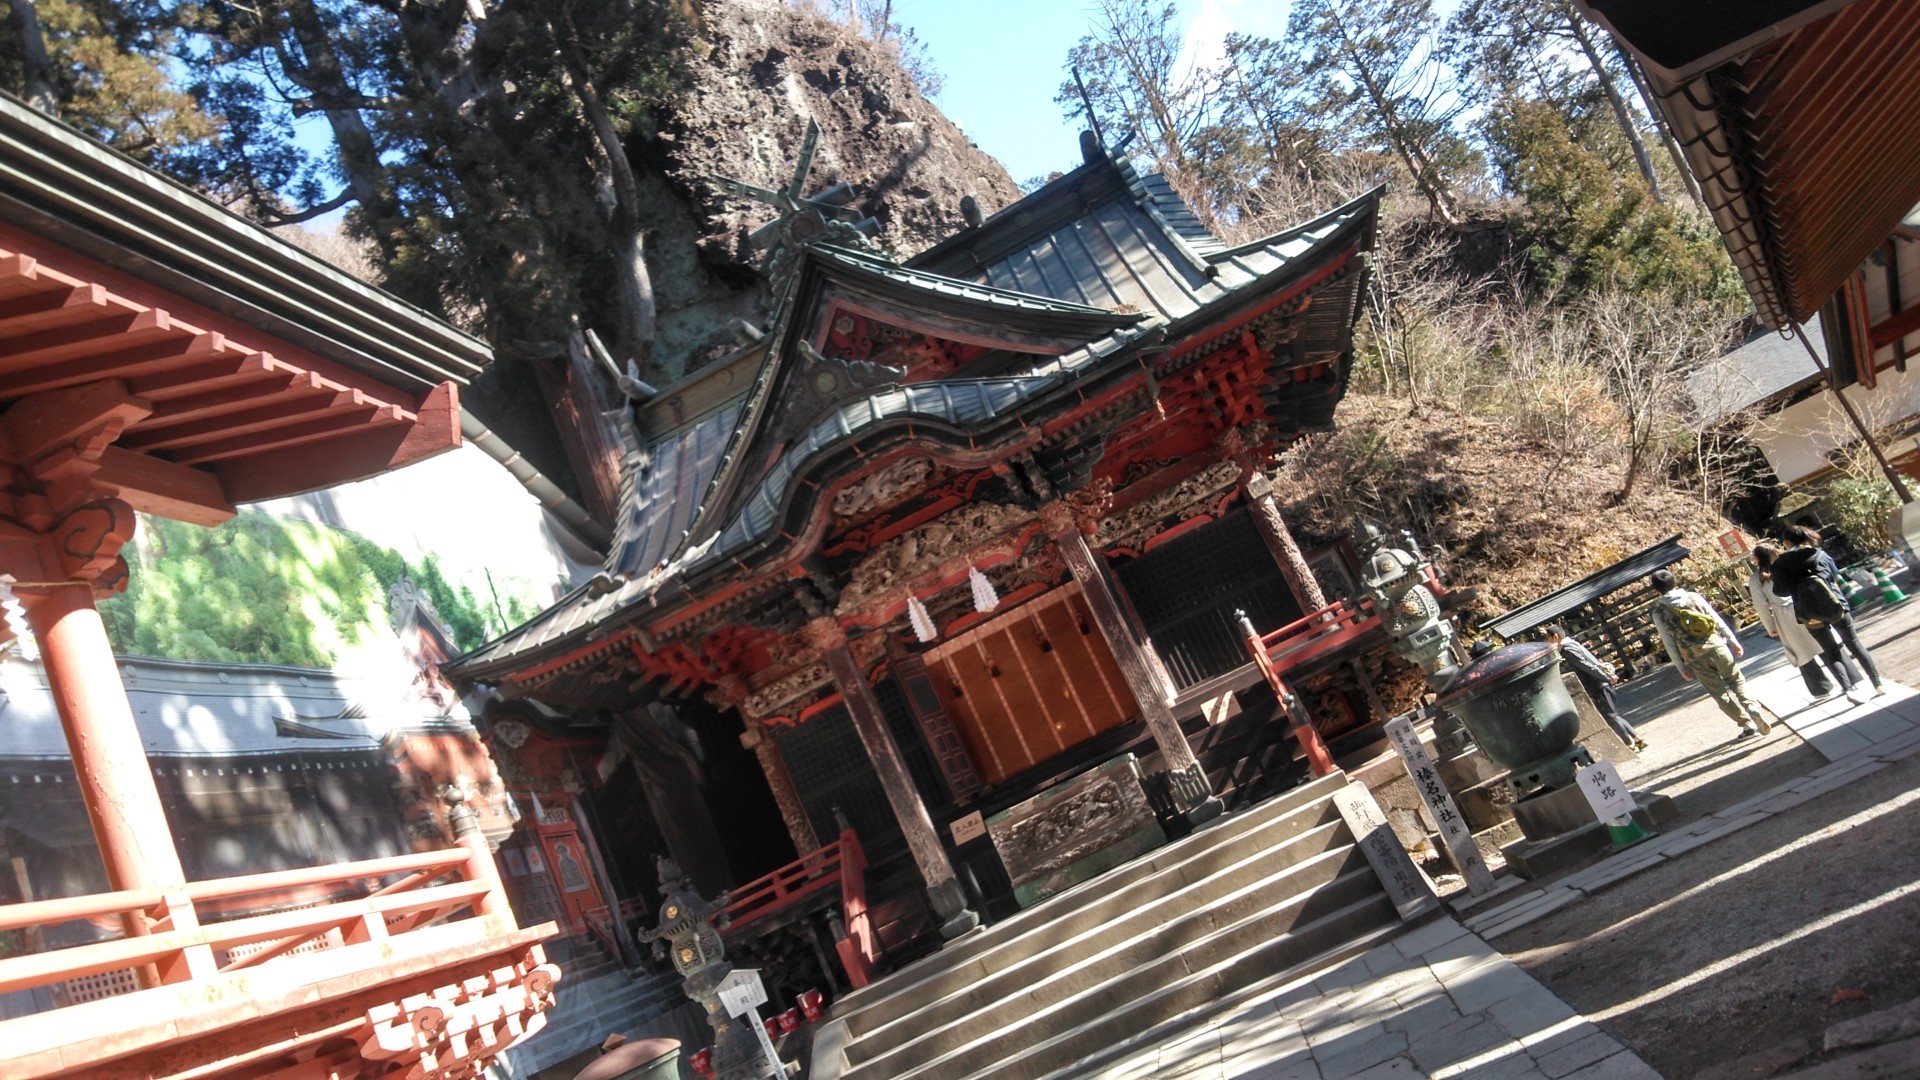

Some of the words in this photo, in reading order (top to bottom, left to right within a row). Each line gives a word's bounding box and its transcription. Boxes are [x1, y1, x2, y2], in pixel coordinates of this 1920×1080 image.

[1416, 767, 1456, 823] 榛名神社
[1592, 770, 1617, 801] 帰路
